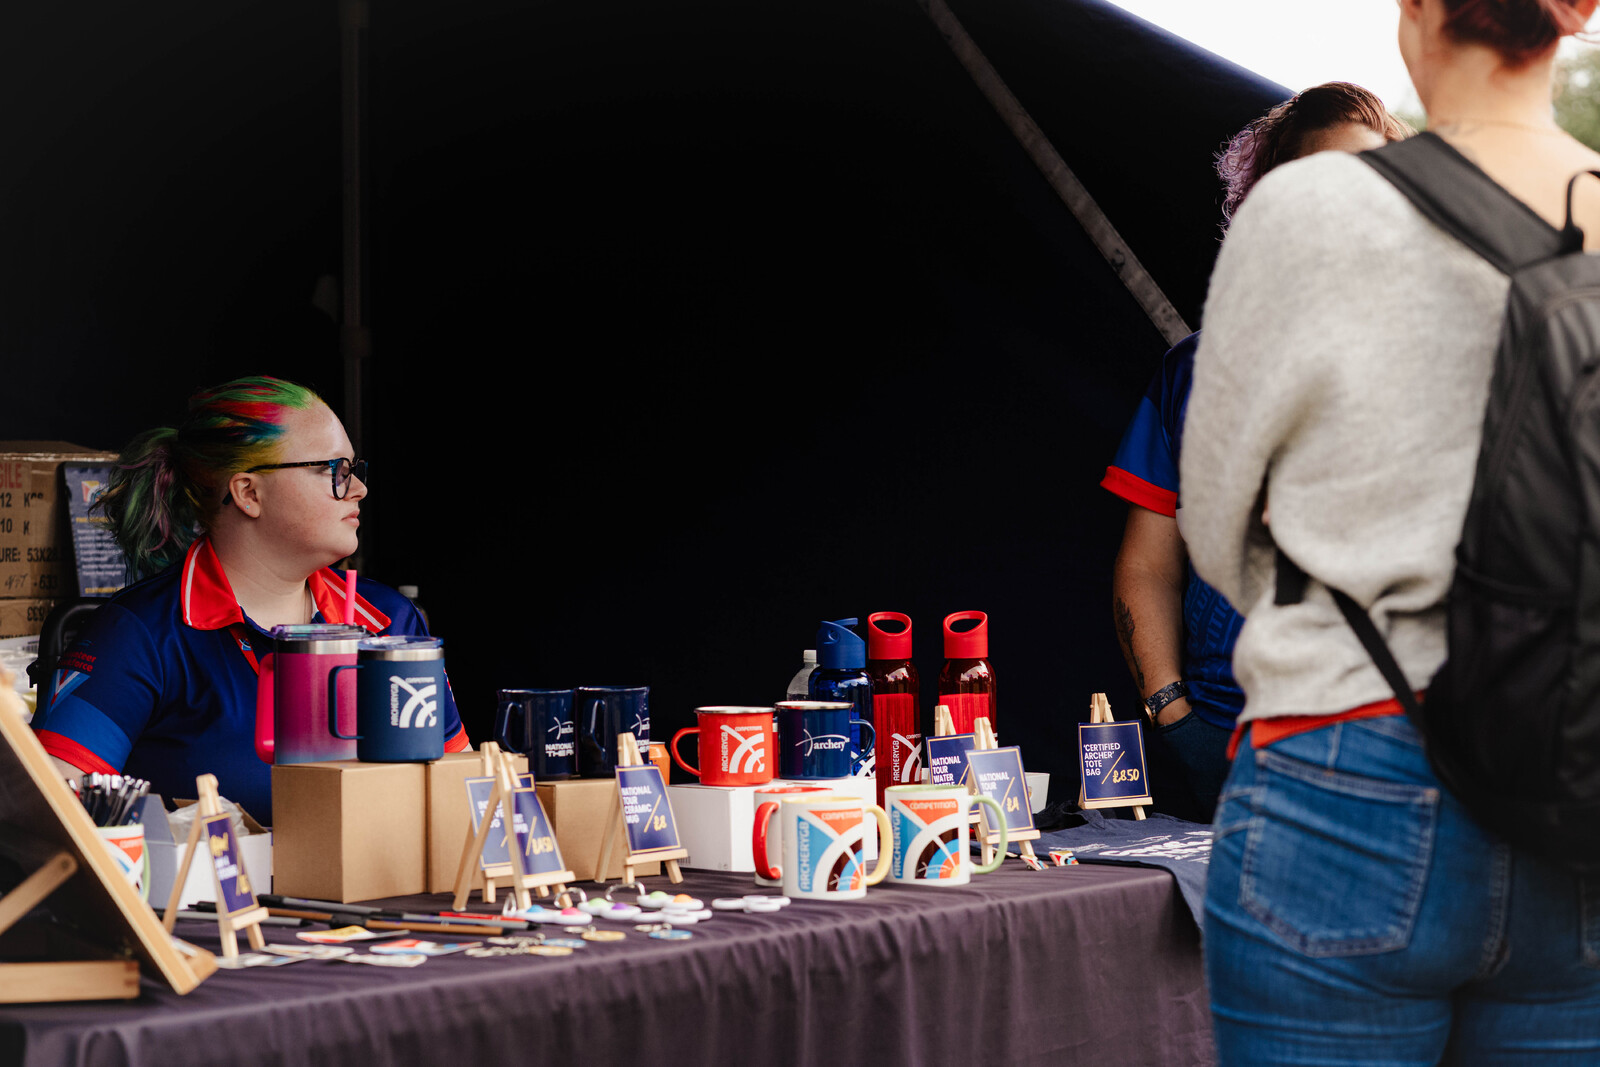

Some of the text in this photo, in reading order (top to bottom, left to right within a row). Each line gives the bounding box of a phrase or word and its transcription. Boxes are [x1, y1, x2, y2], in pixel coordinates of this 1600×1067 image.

[813, 738, 846, 752] archery
[721, 731, 729, 772] ARCHERYGB
[931, 756, 961, 766] NATIONAL
[1084, 760, 1103, 768] TOTE
[932, 766, 949, 775] TOUR
[1085, 768, 1101, 777] BAG
[933, 774, 954, 784] WATER
[978, 771, 1010, 782] NATIONAL
[981, 781, 997, 791] TOUR
[623, 796, 638, 805] TOUR
[625, 803, 653, 814] CERAMIC
[892, 810, 902, 877] ARCHERYGB
[799, 821, 810, 890] ARCHERYGB
